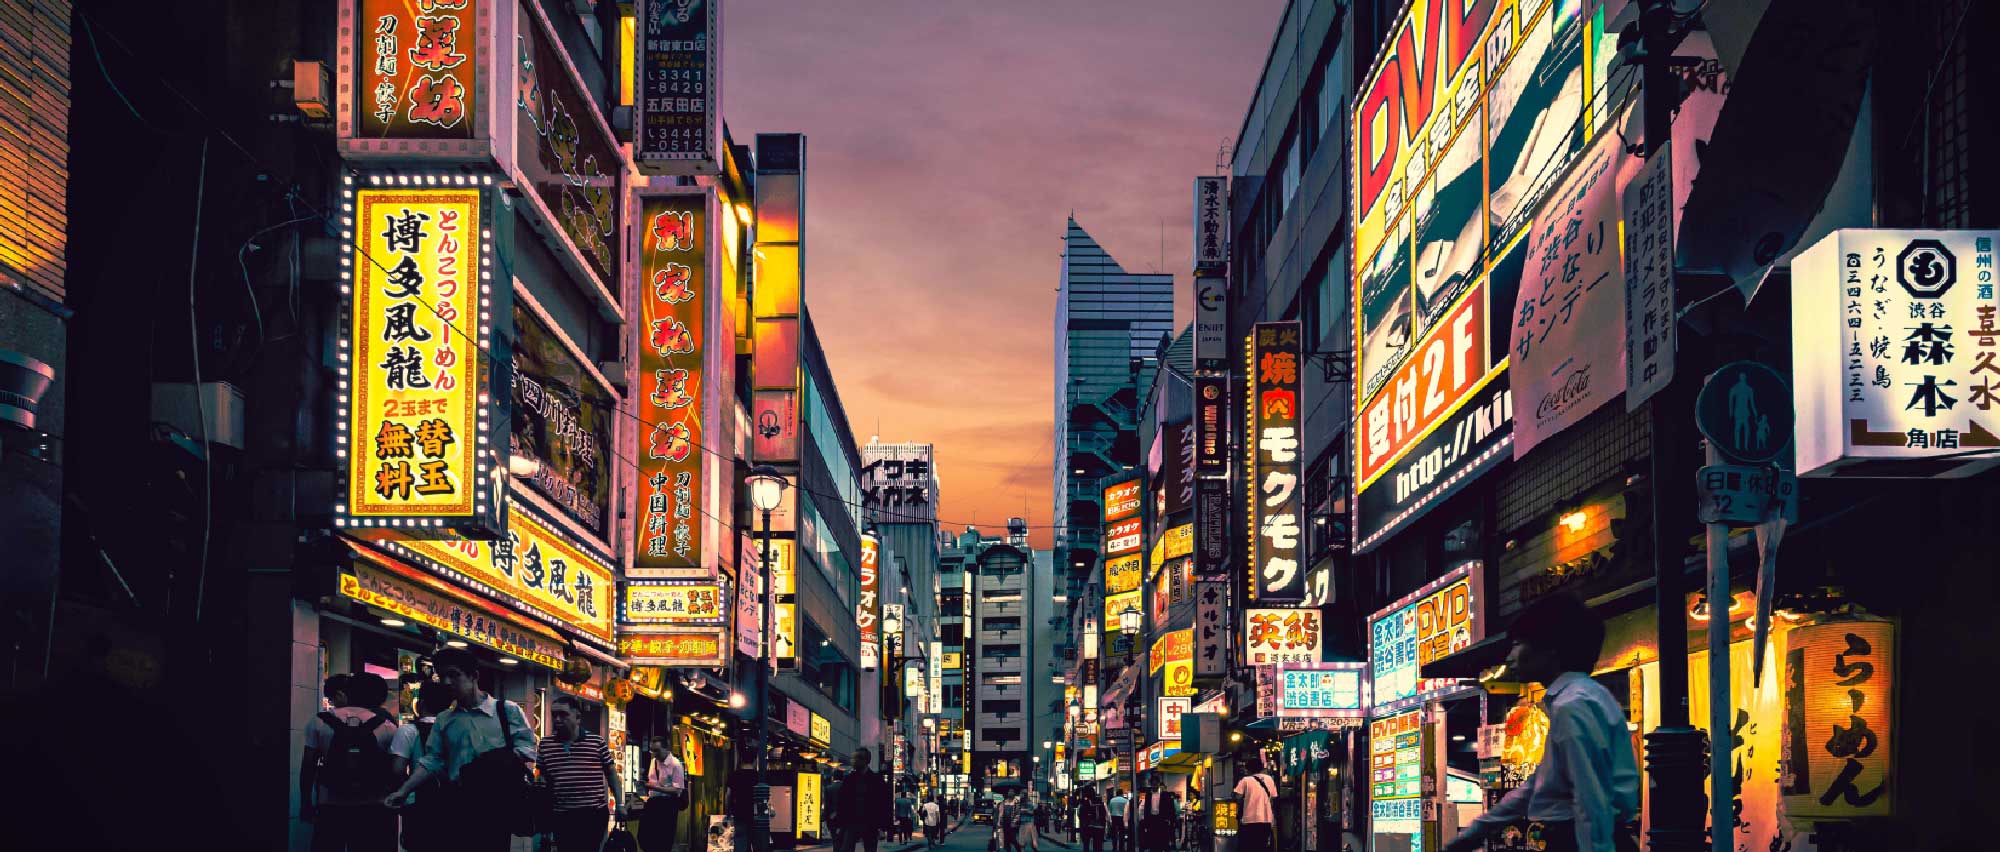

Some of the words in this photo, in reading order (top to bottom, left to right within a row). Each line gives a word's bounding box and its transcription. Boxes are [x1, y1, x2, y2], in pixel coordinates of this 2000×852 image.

[408, 0, 467, 128] 菜坊
[647, 40, 706, 51] 新宿東口店
[646, 98, 705, 113] 五反田店
[1518, 221, 1605, 329] おとなり
[1541, 209, 1582, 271] 渋谷
[1639, 177, 1658, 383] 防犯カメラ作動中
[1976, 237, 1993, 299] 信州の酒
[381, 209, 431, 391] 博多風龍
[436, 209, 459, 390] とんこつらーめん
[1516, 272, 1609, 361] サンデー
[1869, 247, 1891, 388] うなぎ・焼鳥
[1910, 302, 1946, 319] 渋谷
[383, 397, 448, 418] 2玉まで
[1258, 352, 1297, 420] 焼肉
[1368, 303, 1474, 468] 受付2F
[1901, 322, 1958, 417] 森本
[375, 420, 415, 501] 無料
[415, 420, 456, 497] 替玉
[1906, 428, 1959, 450] 角店
[648, 470, 669, 559] 中国料理
[1107, 522, 1140, 537] カラオケ
[1259, 427, 1300, 593] モクモク
[485, 529, 594, 619] 博多風龍
[857, 547, 876, 629] カラオケ
[1417, 583, 1470, 641] DVD
[1286, 672, 1320, 689] 金太郎
[1286, 690, 1331, 707] 渋谷書店
[1821, 632, 1887, 807] らーめん
